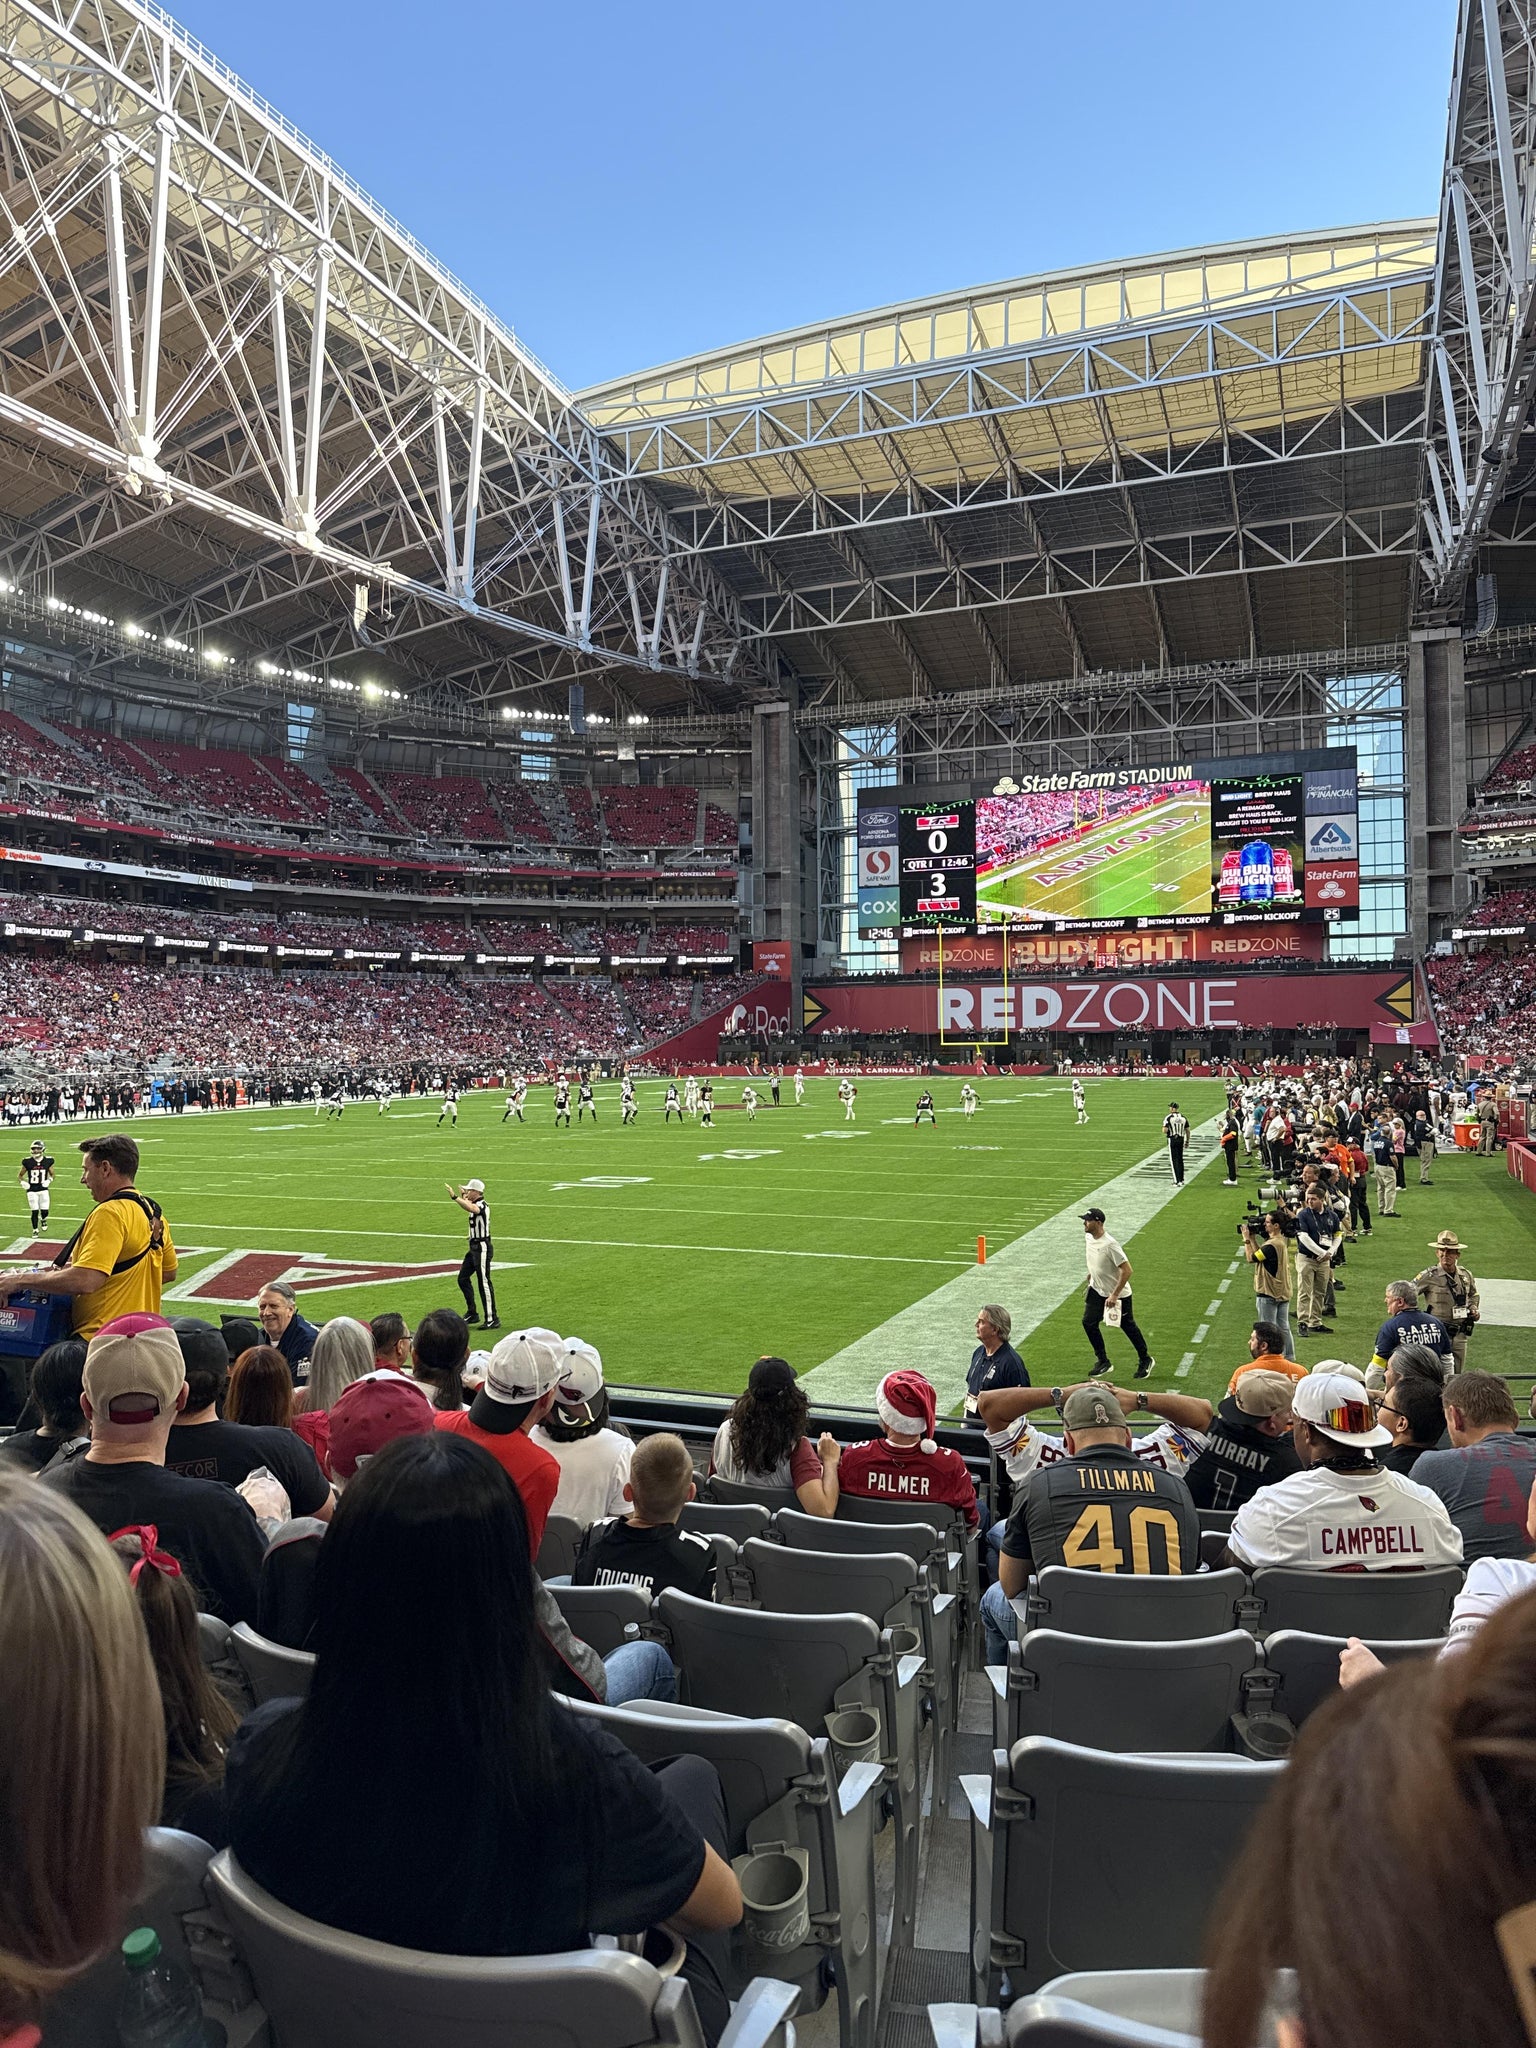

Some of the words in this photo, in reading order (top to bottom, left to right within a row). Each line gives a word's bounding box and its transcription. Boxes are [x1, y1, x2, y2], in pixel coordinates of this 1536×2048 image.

[1118, 765, 1193, 786] STADIUM
[26, 808, 50, 818] ROGER
[1478, 822, 1498, 830] JOHN
[1500, 818, 1532, 828] (PADDY)
[170, 833, 196, 842] CHARLEY
[928, 830, 947, 853] 0
[908, 860, 927, 870] QTR
[942, 858, 968, 867] 12:46
[1243, 864, 1271, 876] BUD
[1273, 866, 1290, 874] UD
[1223, 869, 1240, 878] BU
[930, 873, 946, 896] 3
[862, 900, 897, 914] COX
[1176, 916, 1210, 925] KICKOFF
[1264, 912, 1300, 921] KICKOFF
[1012, 923, 1043, 932] KICKOFF
[1092, 920, 1125, 928] KICKOFF
[42, 928, 72, 938] KICKOFF
[868, 928, 893, 939] 12:46
[1490, 927, 1526, 935] KICKOFF
[117, 934, 144, 943] KICKOFF
[184, 940, 210, 948] KICKOFF
[1211, 937, 1300, 953] REDZONE
[1015, 940, 1082, 964] BUD
[937, 981, 1238, 1029] REDZONE
[1469, 1128, 1480, 1140] G
[31, 1170, 46, 1184] 81
[1398, 1324, 1440, 1336] S.A.F.E.
[1400, 1333, 1441, 1345] SECURITY
[1206, 1432, 1270, 1472] MURRAY
[868, 1472, 929, 1496] PALMER
[1077, 1468, 1156, 1493] TILLMAN
[1062, 1504, 1182, 1575] 40
[1322, 1526, 1424, 1554] CAMPBELL
